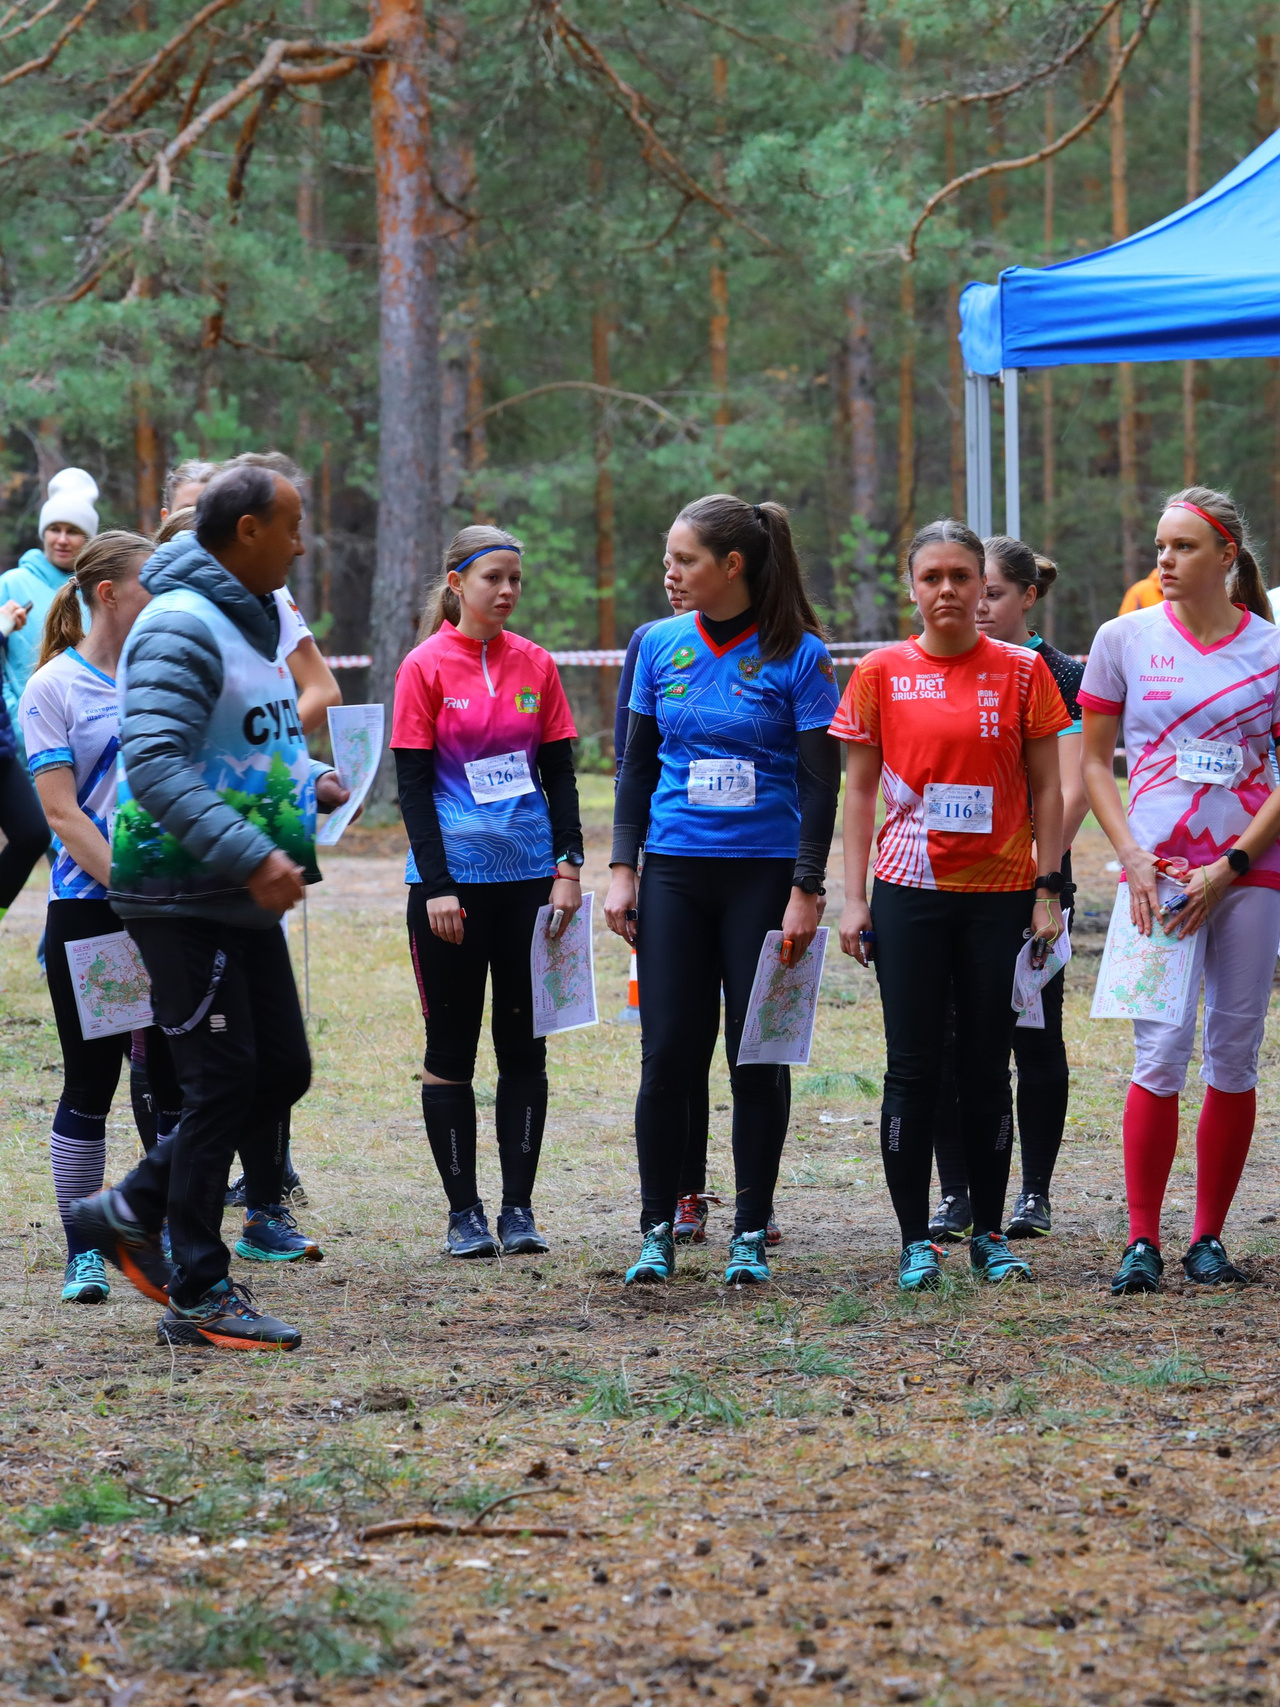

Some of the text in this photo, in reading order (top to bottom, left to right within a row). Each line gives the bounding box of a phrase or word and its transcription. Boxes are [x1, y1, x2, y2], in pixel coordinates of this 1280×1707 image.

[890, 676, 945, 692] 10 лет
[1139, 674, 1184, 683] noname
[891, 690, 946, 702] SIRIUS SOCHI
[978, 697, 1000, 707] LADY
[243, 699, 304, 746] СУД
[979, 711, 1000, 724] 20
[979, 725, 1000, 738] 24
[1196, 755, 1225, 773] 115
[486, 768, 514, 787] 126
[708, 775, 736, 792] 117
[944, 802, 973, 819] 116
